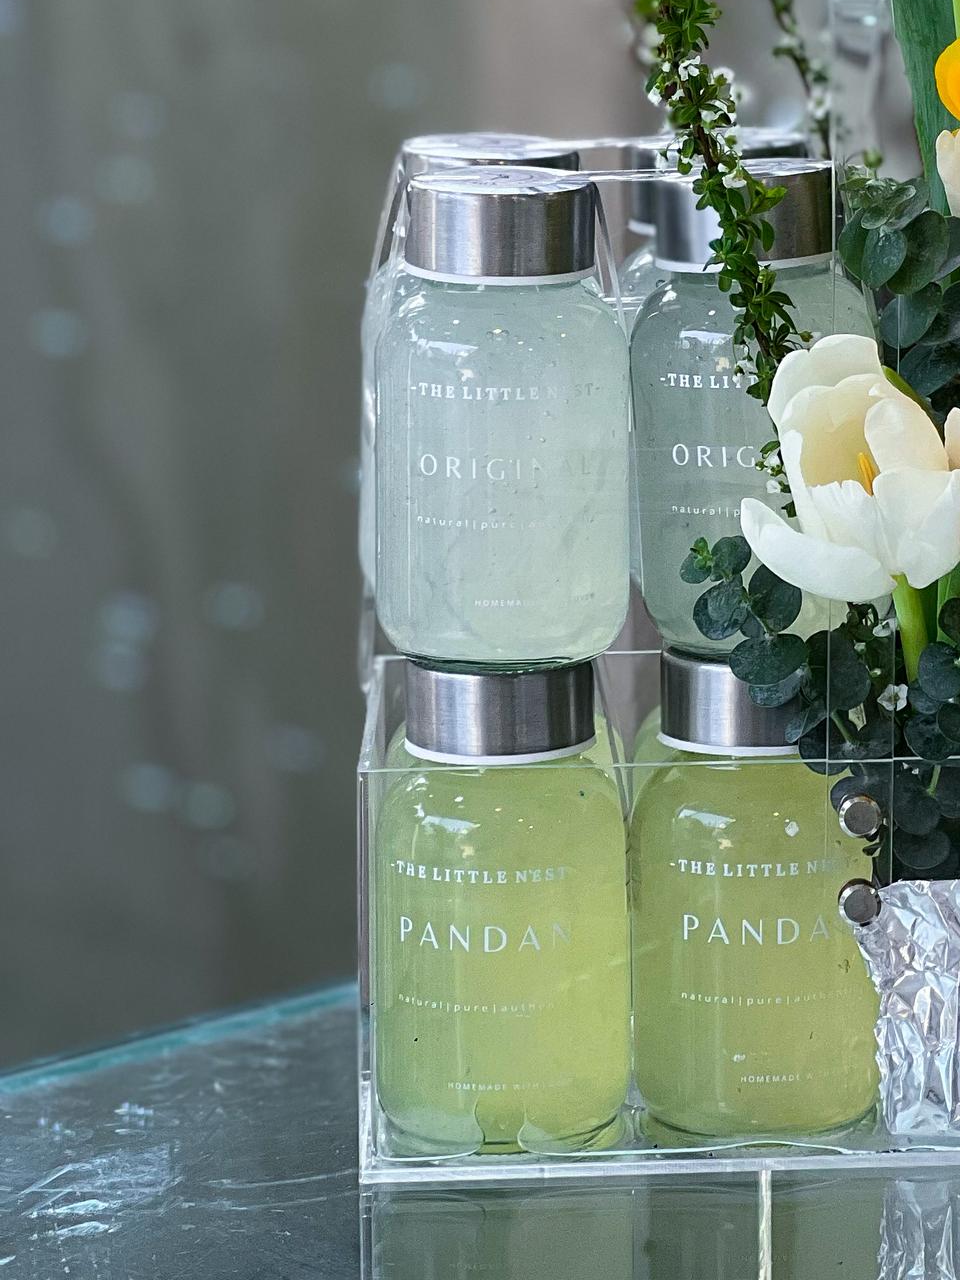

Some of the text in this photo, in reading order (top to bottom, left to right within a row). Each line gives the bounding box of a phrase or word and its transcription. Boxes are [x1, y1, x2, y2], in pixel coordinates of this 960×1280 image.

[461, 386, 541, 402] LITTLE
[672, 443, 756, 468] ORIG
[432, 867, 508, 884] LITTLE
[723, 863, 799, 878] LITTLE
[399, 915, 573, 953] PANDAN
[682, 913, 831, 946] PANDA
